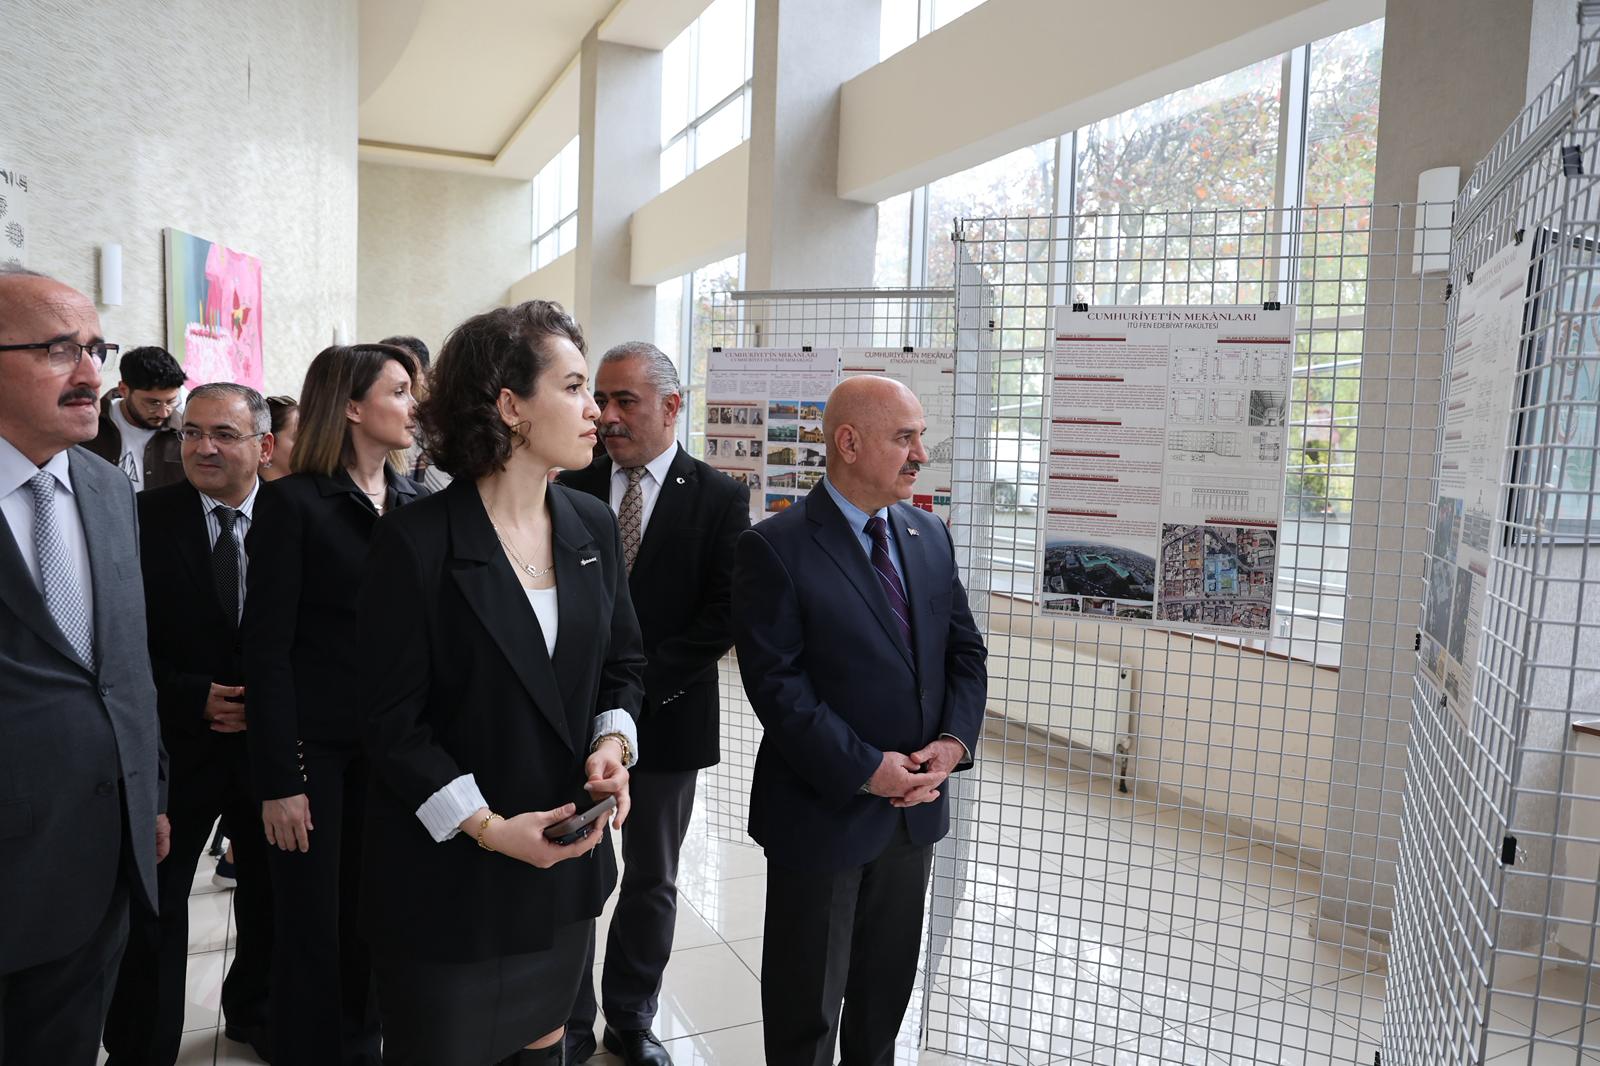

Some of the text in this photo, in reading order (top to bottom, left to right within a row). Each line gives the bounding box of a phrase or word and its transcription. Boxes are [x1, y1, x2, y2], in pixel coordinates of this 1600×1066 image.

[1087, 311, 1257, 321] CUMHURİYET'İN MEKÂNLARI
[921, 351, 954, 359] MEKÂNLA
